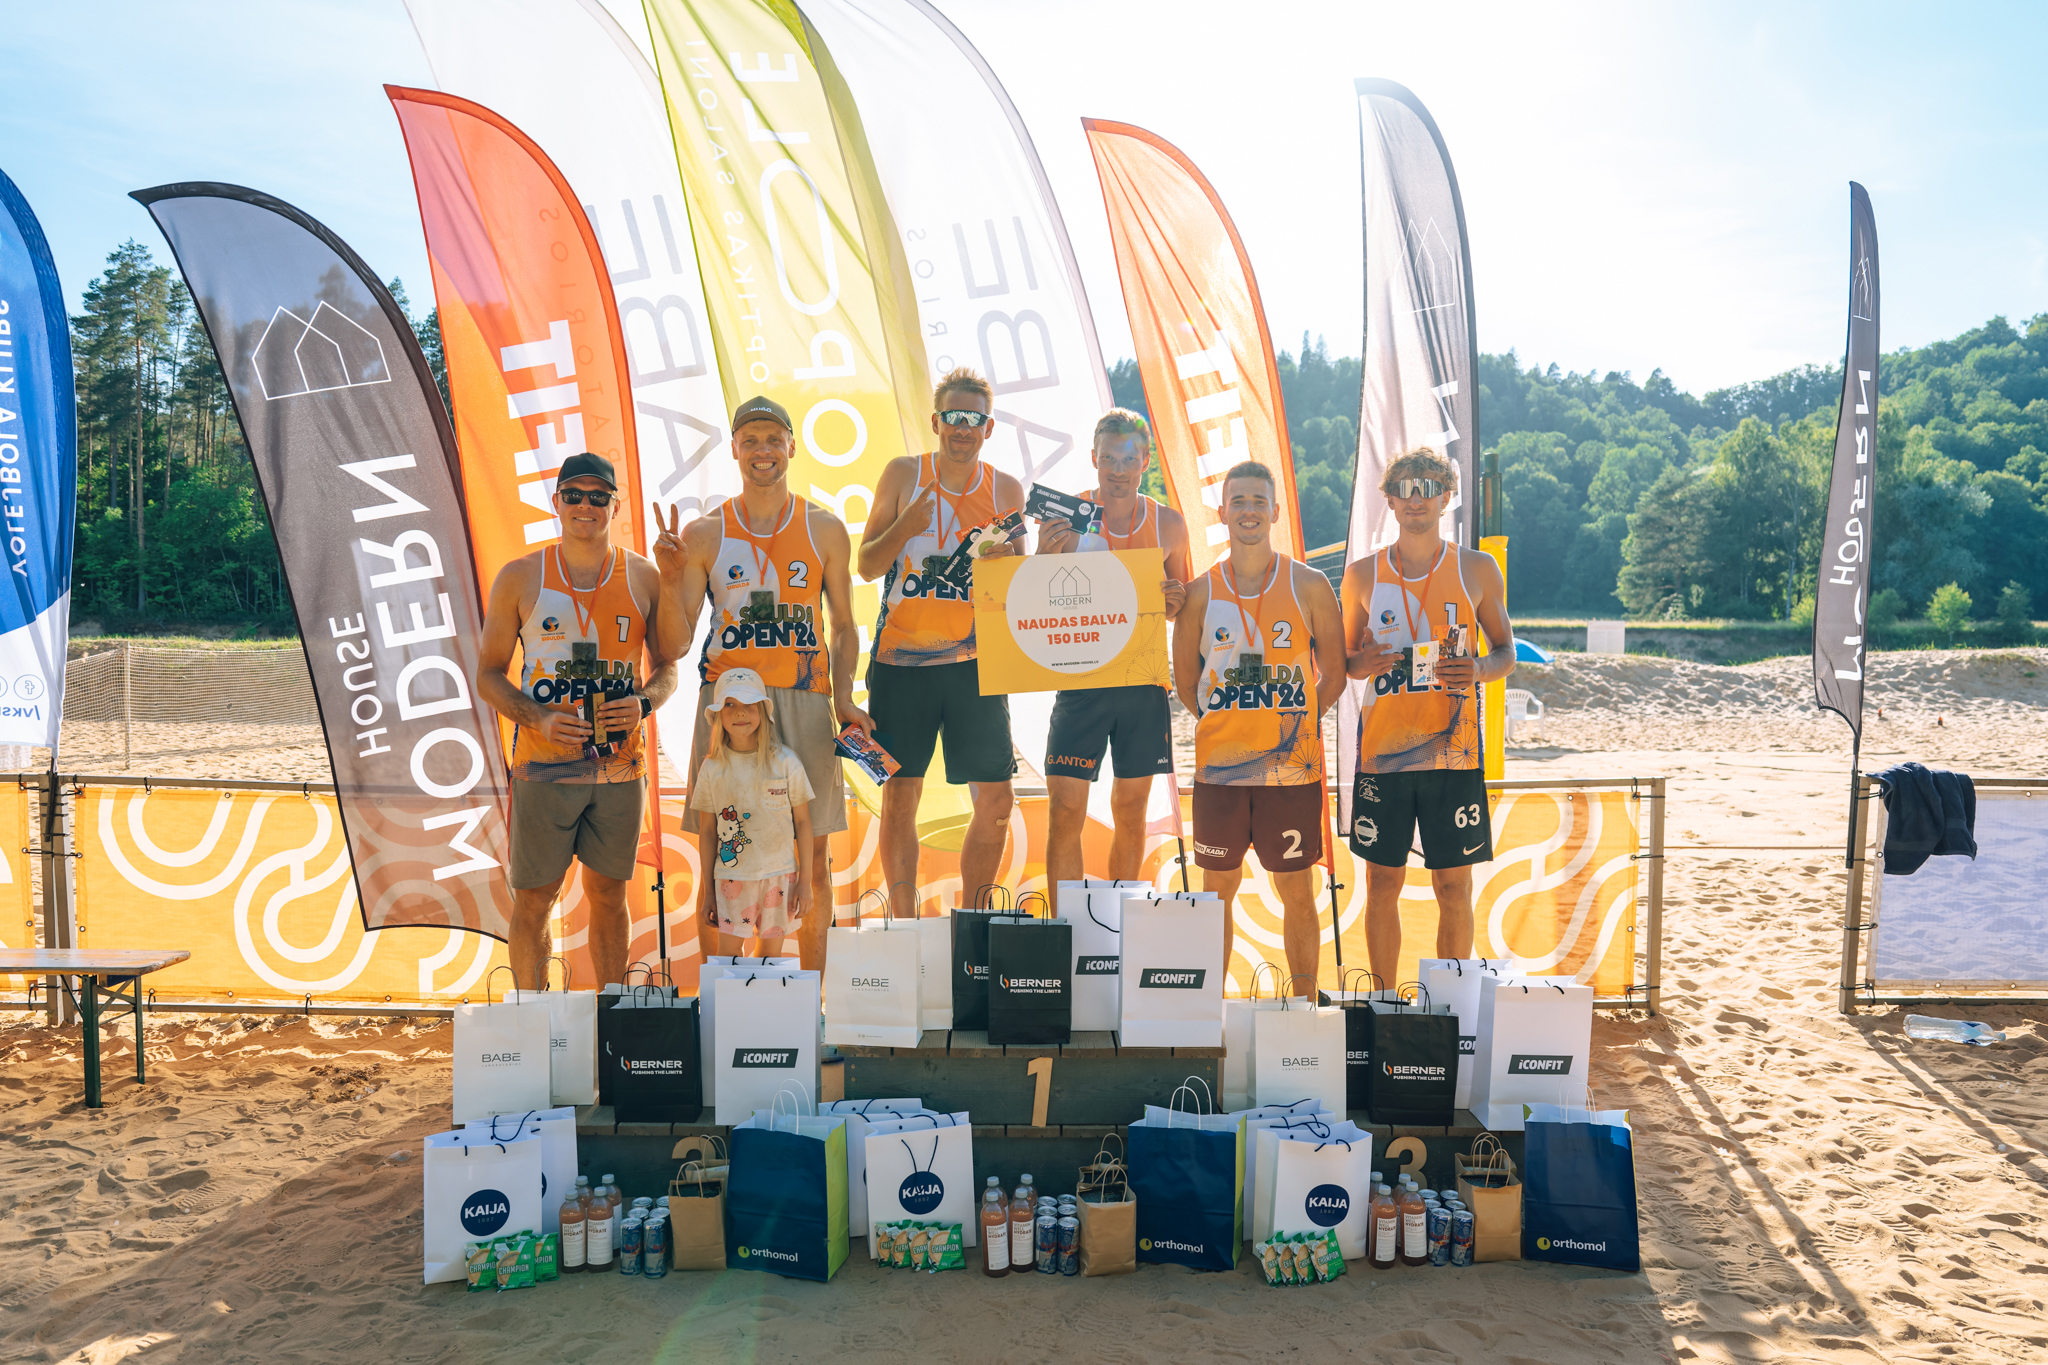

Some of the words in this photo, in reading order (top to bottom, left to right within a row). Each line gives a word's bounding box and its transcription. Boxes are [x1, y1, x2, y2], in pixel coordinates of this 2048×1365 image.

[788, 560, 808, 588] 2
[726, 582, 750, 590] SIGULDA
[1050, 596, 1092, 606] MODERN
[739, 604, 814, 624] SULDA
[1444, 602, 1458, 626] 1
[1017, 616, 1078, 630] NAUDAS
[1080, 613, 1128, 626] BALVA
[616, 615, 630, 642] 1
[1272, 620, 1292, 648] 2
[1047, 633, 1072, 645] 150
[1074, 631, 1100, 644] EUR
[1224, 665, 1305, 686] SIULDA
[852, 734, 871, 748] KARTE
[1454, 803, 1481, 828] 63
[1281, 829, 1303, 860] 2
[852, 977, 890, 988] BABE
[1010, 978, 1062, 988] BERNER
[1150, 972, 1196, 984] iCONFIT
[550, 1038, 568, 1048] BE
[482, 1052, 521, 1062] BABE
[742, 1052, 790, 1064] iCONFIT
[1282, 1057, 1319, 1066] BABE
[631, 1060, 682, 1069] BERNER
[1393, 1066, 1446, 1075] BERNER
[1518, 1060, 1564, 1070] iCONFIT
[1026, 1056, 1054, 1128] 1
[1384, 1136, 1428, 1191] 3
[902, 1184, 942, 1200] KAIJA
[1308, 1196, 1348, 1209] KAIJA
[464, 1202, 508, 1219] KAIJA
[931, 1243, 960, 1254] CHAMPION
[1154, 1240, 1204, 1253] orthomol
[1552, 1238, 1606, 1252] orthomol
[535, 1254, 553, 1264] MPION
[751, 1248, 798, 1262] orthomol
[1317, 1250, 1340, 1266] CHAMPION
[469, 1262, 497, 1273] CHAMPIO
[498, 1264, 530, 1276] CHAMPION
